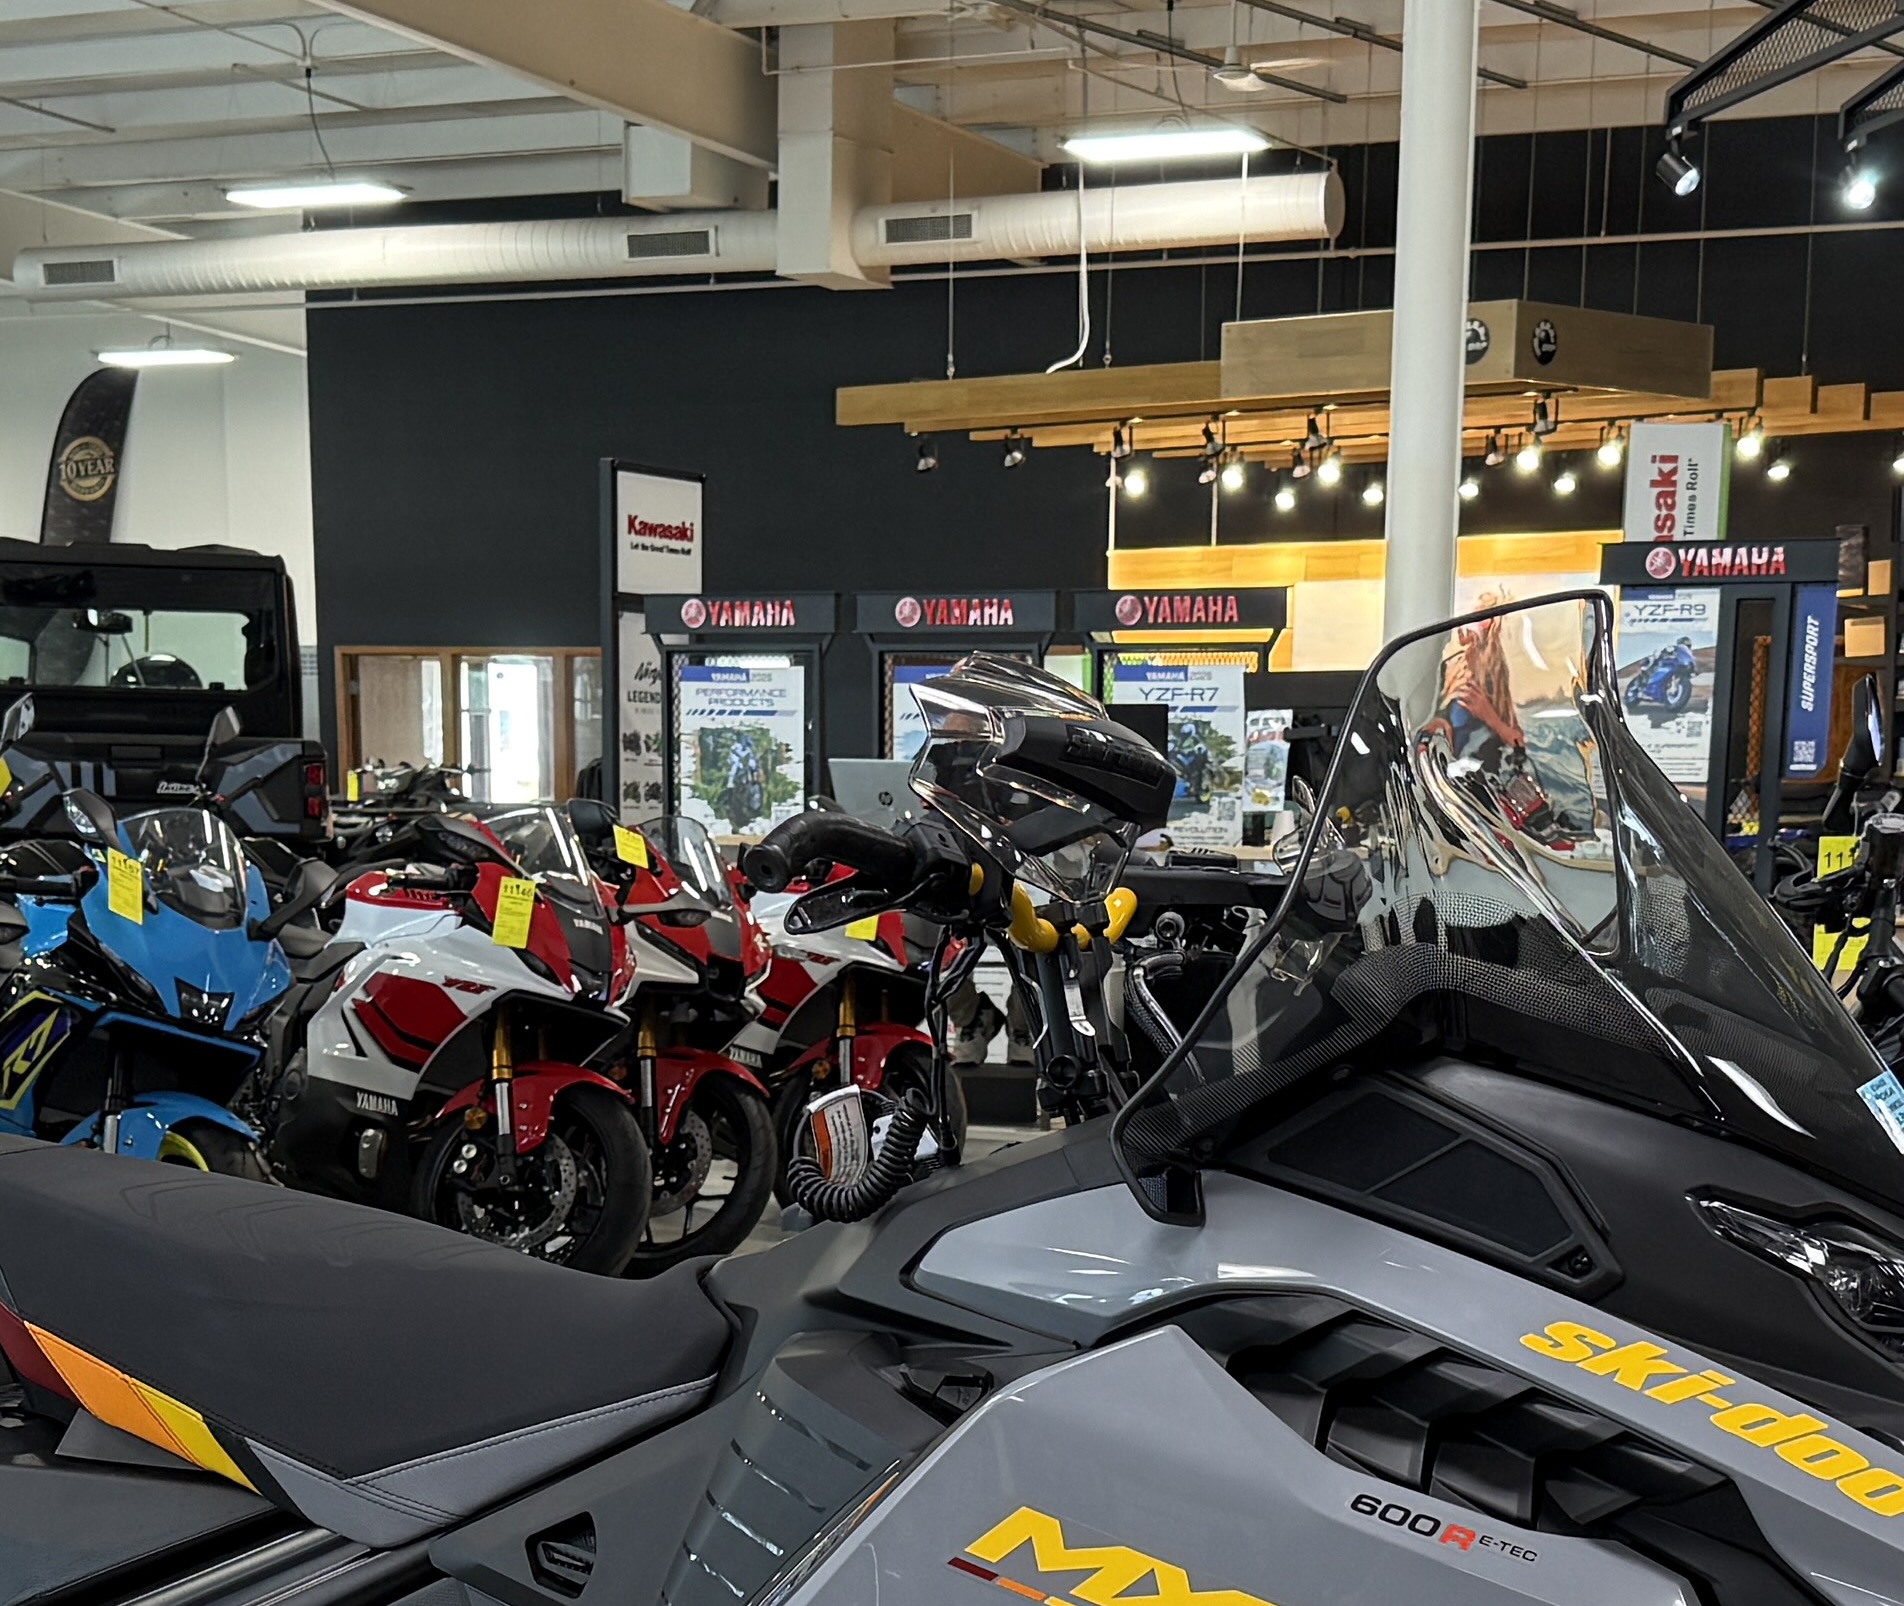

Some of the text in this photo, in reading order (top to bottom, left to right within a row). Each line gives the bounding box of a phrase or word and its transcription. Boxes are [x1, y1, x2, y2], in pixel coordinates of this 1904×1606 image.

[76, 458, 115, 477] YEAR
[627, 514, 694, 543] Kawasaki
[1678, 547, 1784, 576] YAMAHA
[709, 600, 796, 627] YAMAHA
[923, 599, 1014, 626] YAMAHA
[1143, 597, 1239, 623] YAMAHA
[1634, 603, 1707, 617] YZF-R9
[1800, 615, 1820, 712] SUPERSPORT
[1139, 686, 1219, 703] YZF-R7
[1479, 1533, 1539, 1563] E-TEC
